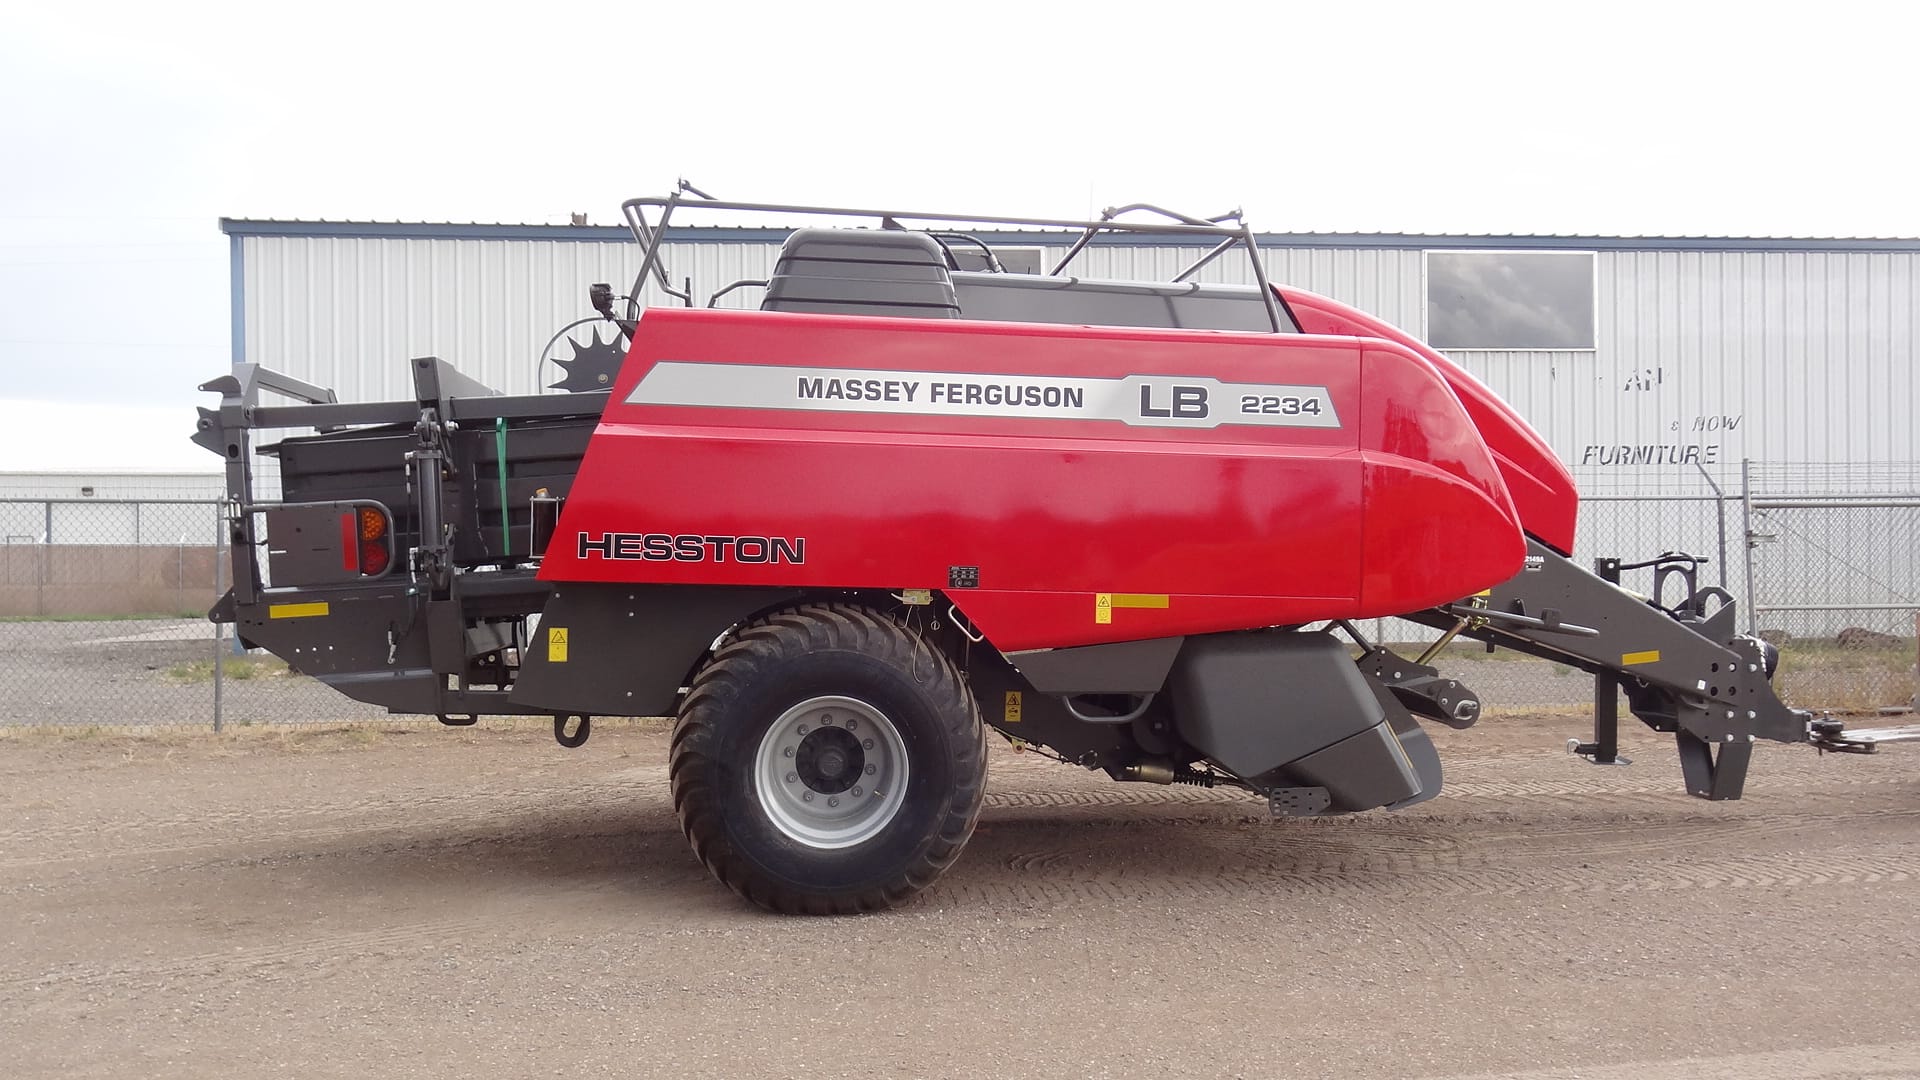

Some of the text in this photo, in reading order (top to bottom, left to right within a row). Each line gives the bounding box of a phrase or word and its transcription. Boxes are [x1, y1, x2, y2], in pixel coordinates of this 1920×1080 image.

[798, 376, 1084, 408] MASSEY FERGUSON
[1141, 385, 1209, 419] LB
[1241, 395, 1321, 416] 2234
[1583, 445, 1719, 465] FURNITURE
[578, 533, 804, 564] HESSTON
